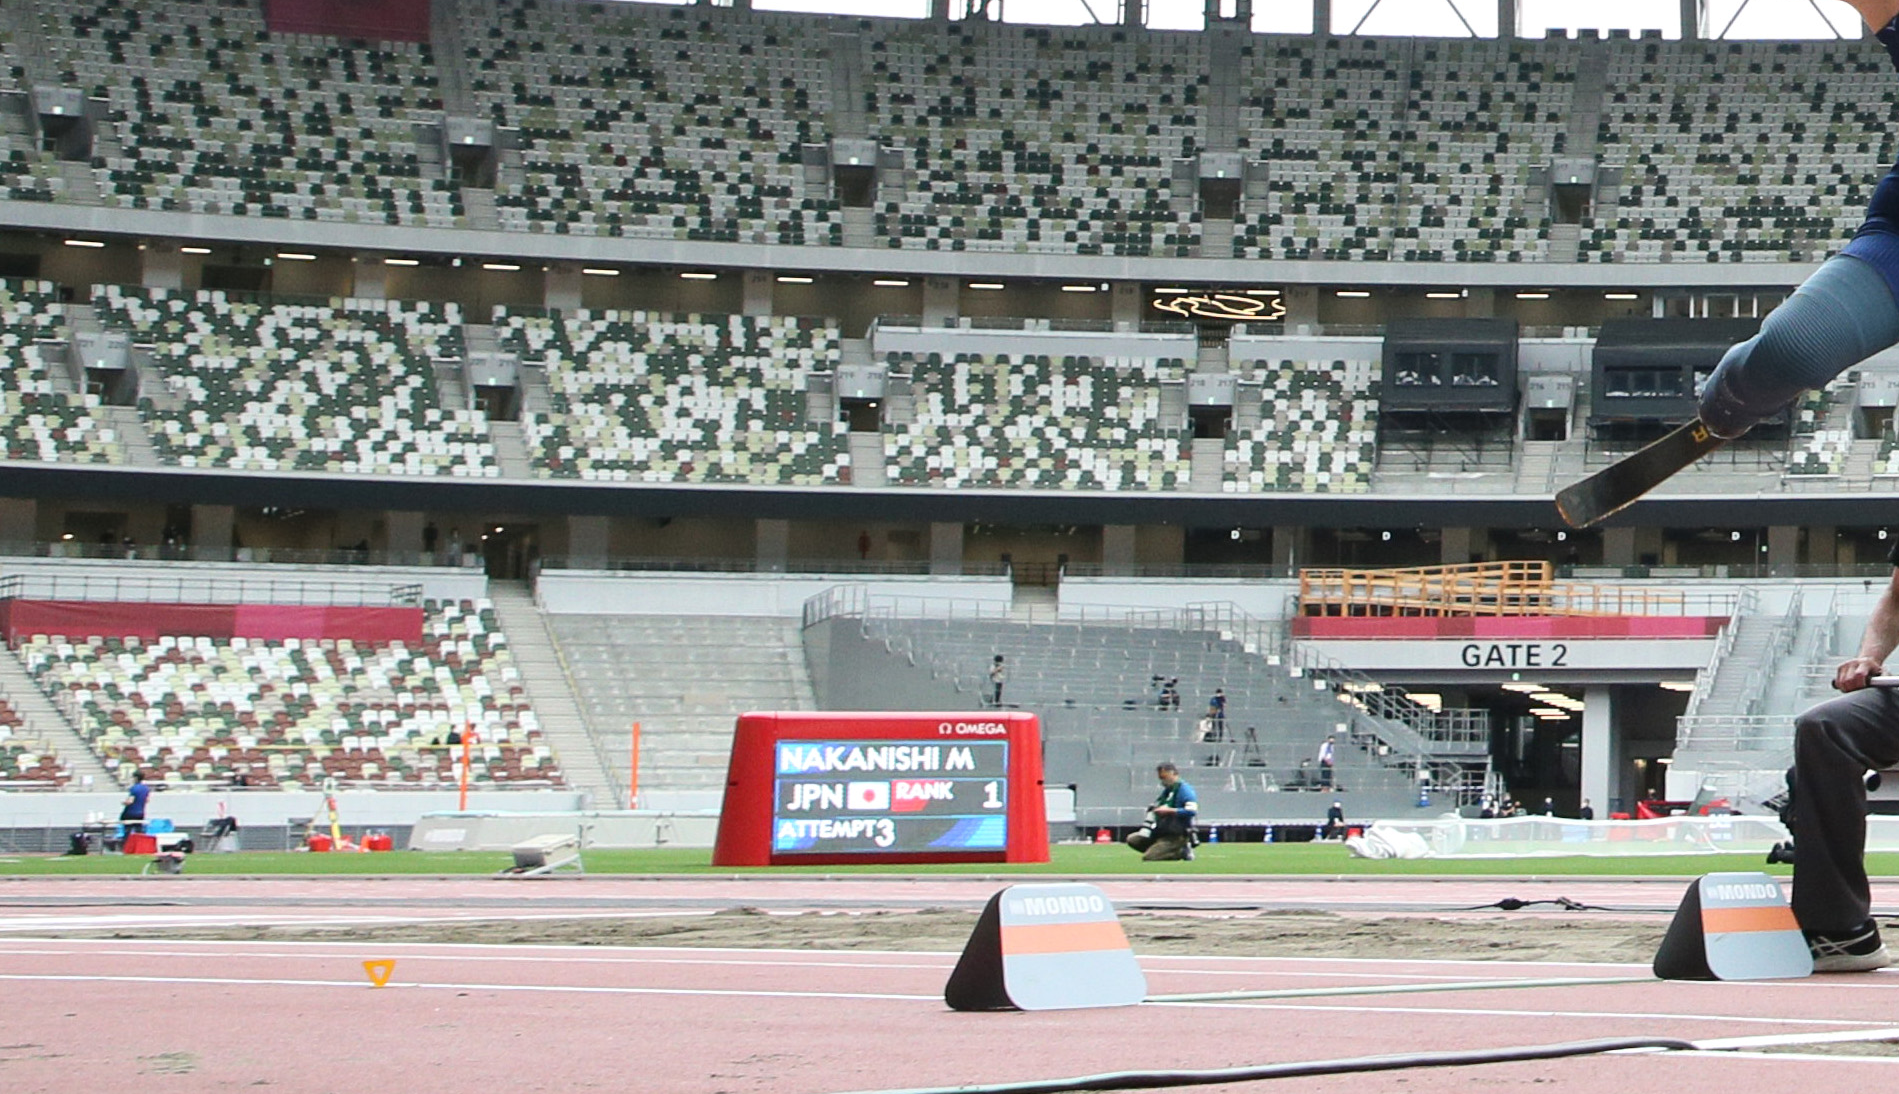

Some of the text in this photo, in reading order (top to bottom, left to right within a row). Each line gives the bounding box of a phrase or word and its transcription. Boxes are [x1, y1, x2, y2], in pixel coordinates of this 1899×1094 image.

[1461, 643, 1568, 667] GATE 2
[955, 723, 1007, 735] OMEGA
[780, 746, 976, 772] NAKANISHI M
[787, 781, 1003, 811] JPN RANK 1
[777, 818, 896, 848] ATTEMPT 3
[1717, 883, 1778, 901] MONDO
[1023, 894, 1105, 916] MONDO
